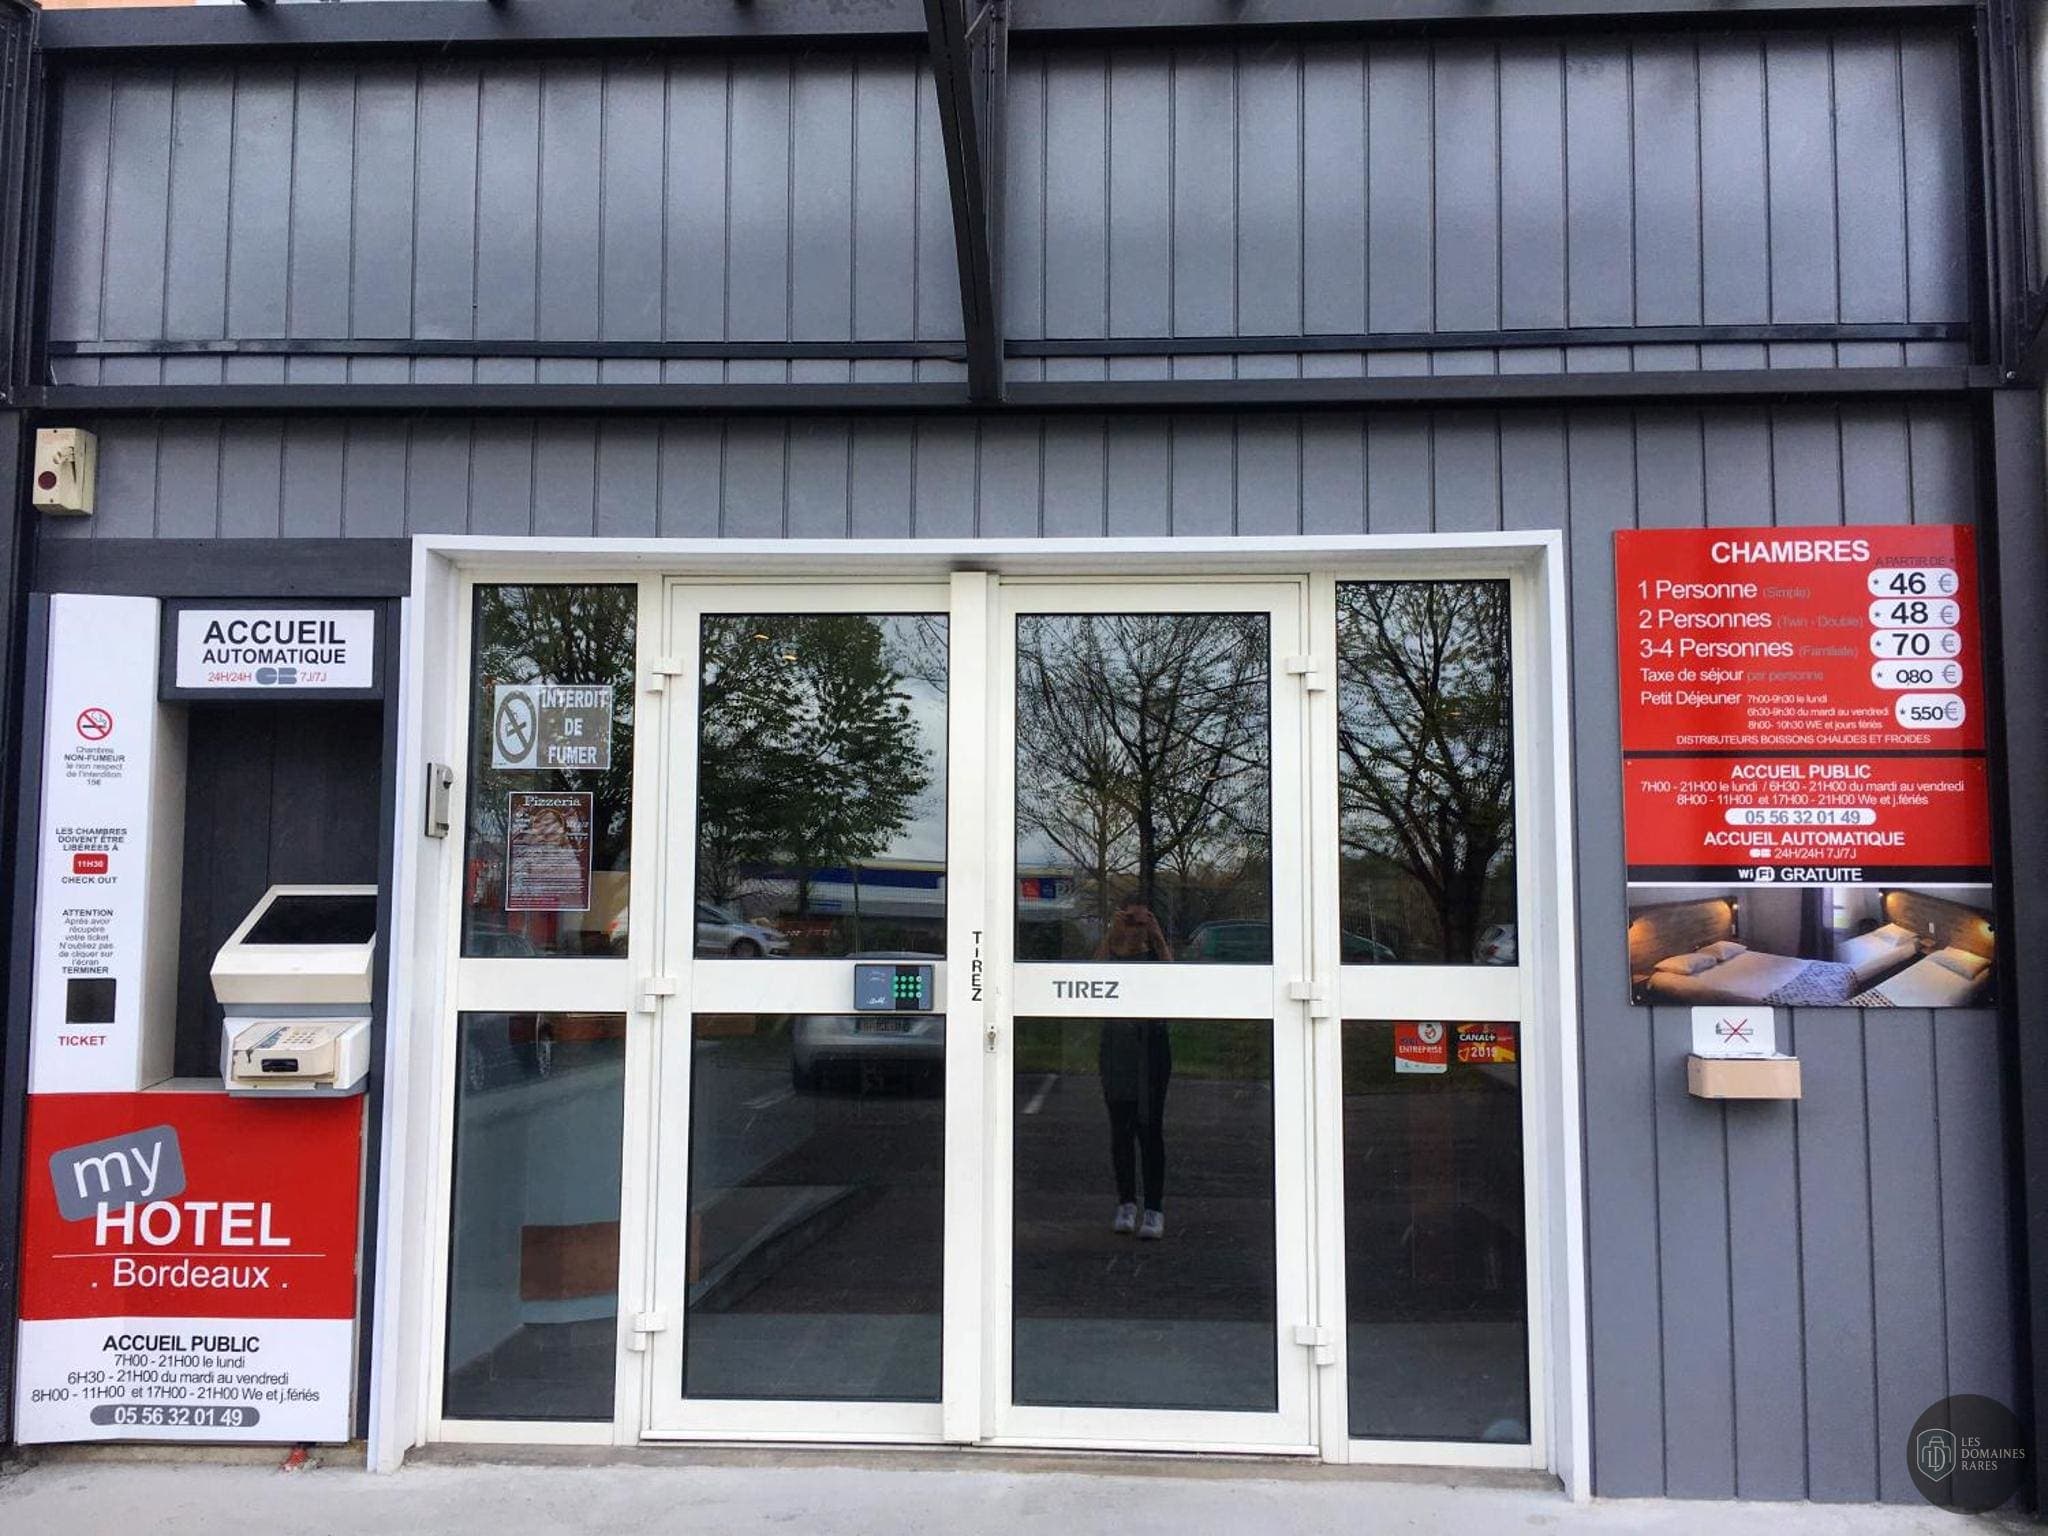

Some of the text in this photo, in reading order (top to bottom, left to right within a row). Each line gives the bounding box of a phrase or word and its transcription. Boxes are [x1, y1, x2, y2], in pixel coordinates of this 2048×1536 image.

[1711, 541, 1870, 563] CHAMBRES
[1638, 580, 1647, 599] 1
[1656, 580, 1758, 599] Personne
[1889, 572, 1926, 595] 46
[1939, 573, 1953, 593] €
[1638, 609, 1652, 628] 2
[1658, 609, 1772, 628] Personnes
[1891, 601, 1928, 624] 48
[1940, 605, 1954, 625] €
[203, 620, 346, 645] ACCUEIL
[1639, 633, 1956, 658] 3-4 Personnes 70 €
[202, 648, 346, 664] AUTOMATIQUE
[208, 672, 252, 682] 24H/24H
[300, 672, 327, 682] 7J/7J
[1640, 668, 1674, 682] Taxe
[1678, 668, 1696, 682] de
[1700, 668, 1744, 684] séjour
[1942, 664, 1957, 684] €
[541, 688, 608, 708] INTERDIT
[1641, 691, 1673, 705] Petit
[1676, 691, 1742, 707] Déjeuner
[1796, 694, 1805, 704] le
[1807, 694, 1827, 704] lundi
[1798, 708, 1809, 717] du
[1838, 708, 1849, 717] au
[565, 718, 583, 736] DE
[1776, 720, 1803, 730] 10h30
[1805, 720, 1822, 730] WE
[1825, 720, 1834, 730] et
[1676, 735, 1931, 744] DISTRIBUTEURS BOISSONS CHAUDES ET FROIDES
[64, 754, 125, 763] NON-FUMEUR
[548, 746, 597, 764] FUMER
[1731, 765, 1871, 779] ACCUEIL PUBLIC
[1641, 781, 1964, 792] 7H00 21H00 le lundi 6H30 21H00 du mardi au vendredi
[523, 795, 581, 807] Pizzeria
[1676, 794, 1708, 805] 8H00
[1718, 794, 1753, 805] 11H00
[1758, 794, 1770, 805] et
[1772, 794, 1809, 805] 17H00
[1816, 794, 1855, 805] 21H00
[1858, 794, 1877, 805] We
[1880, 794, 1891, 805] et
[1745, 810, 1860, 824] 05 56 32 01 49
[1704, 832, 1906, 846] ACCUEIL AUTOMATIQUE
[1774, 848, 1857, 859] 24H/24H 7J/7J
[61, 876, 118, 884] CHECK OUT
[1780, 868, 1863, 881] GRATUITE
[62, 909, 114, 917] ATTENTION
[971, 931, 982, 1001] TIREZ
[1052, 981, 1119, 999] TIREZ
[58, 1036, 107, 1046] TICKET
[1459, 1034, 1496, 1042] CANAL+
[73, 1141, 162, 1198] my
[95, 1201, 291, 1246] HOTEL
[113, 1258, 270, 1288] Bordeaux
[103, 1335, 260, 1353] ACCUEIL PUBLIC
[114, 1354, 245, 1369] 7H00 21H00 le lundi
[67, 1371, 289, 1385] 6H30 21H00 du mardi au vendredi
[31, 1388, 69, 1402] 8H00
[82, 1386, 125, 1399] 11H00
[131, 1387, 143, 1399] et
[146, 1386, 187, 1400] 17H00
[197, 1387, 239, 1401] 21H00
[241, 1388, 262, 1401] We
[264, 1388, 277, 1401] et
[114, 1406, 243, 1426] 05 56 32 01 49
